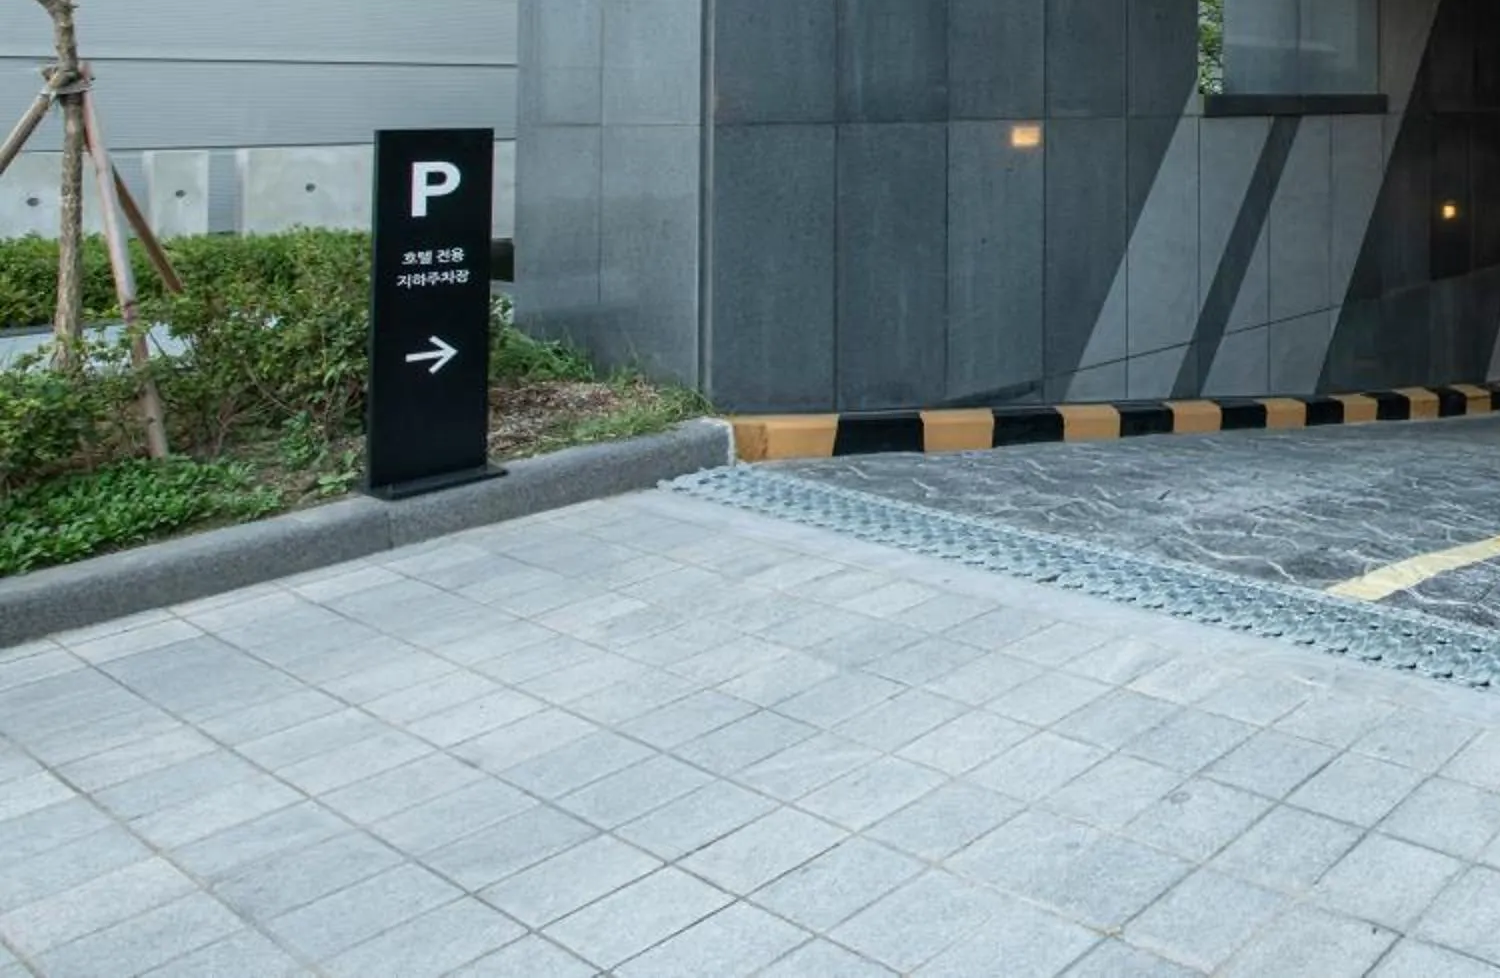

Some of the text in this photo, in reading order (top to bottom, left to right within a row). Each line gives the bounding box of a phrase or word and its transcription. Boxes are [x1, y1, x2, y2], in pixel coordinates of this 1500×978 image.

[411, 160, 461, 217] P
[401, 246, 465, 265] 호텔 전용
[396, 269, 470, 290] 지하주차장
